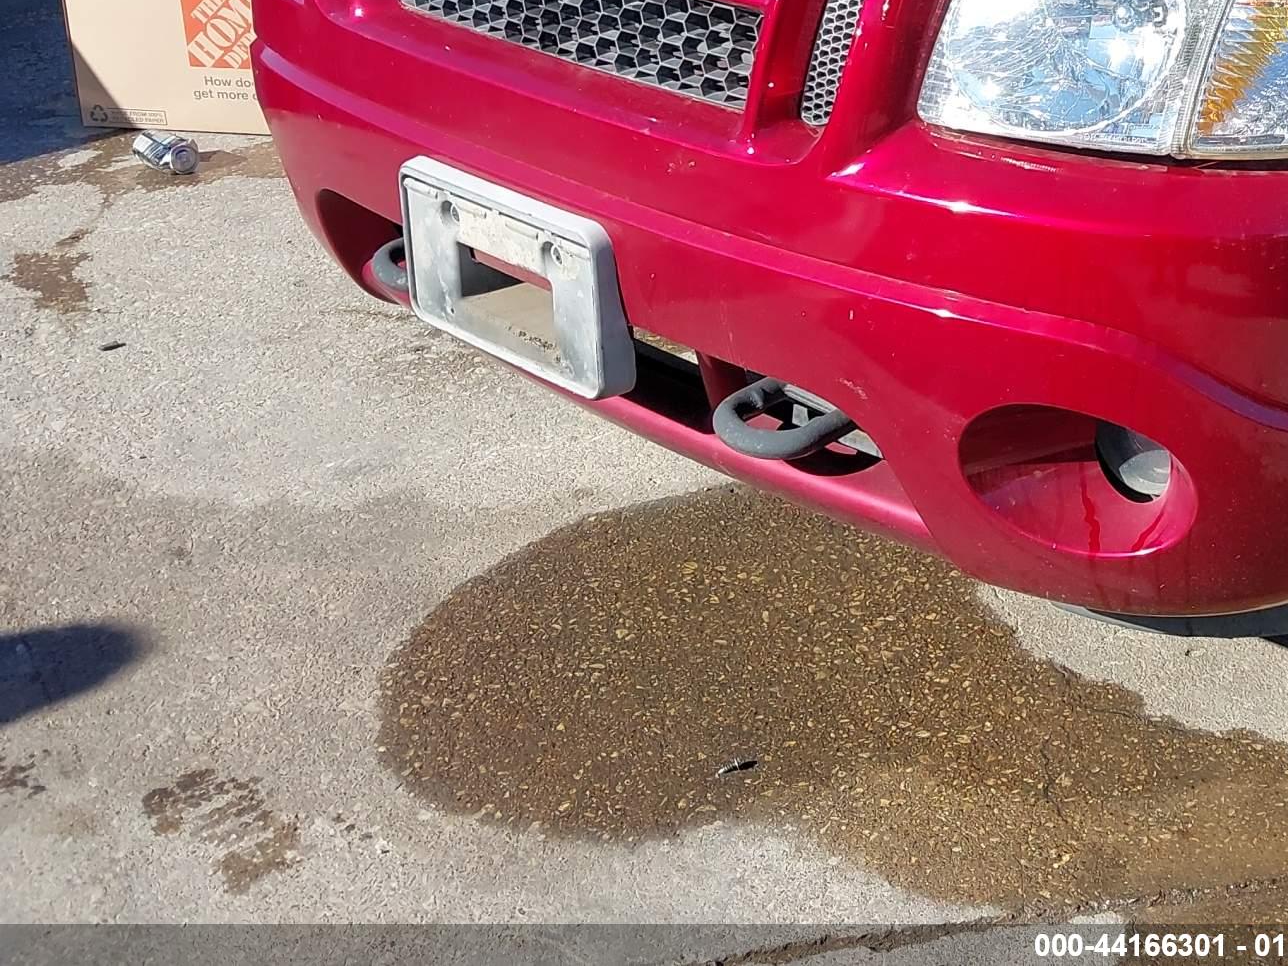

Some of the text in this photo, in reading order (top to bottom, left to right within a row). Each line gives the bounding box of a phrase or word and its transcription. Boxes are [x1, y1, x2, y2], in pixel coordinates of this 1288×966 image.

[204, 75, 254, 88] How do
[193, 89, 215, 100] get
[217, 91, 249, 100] more
